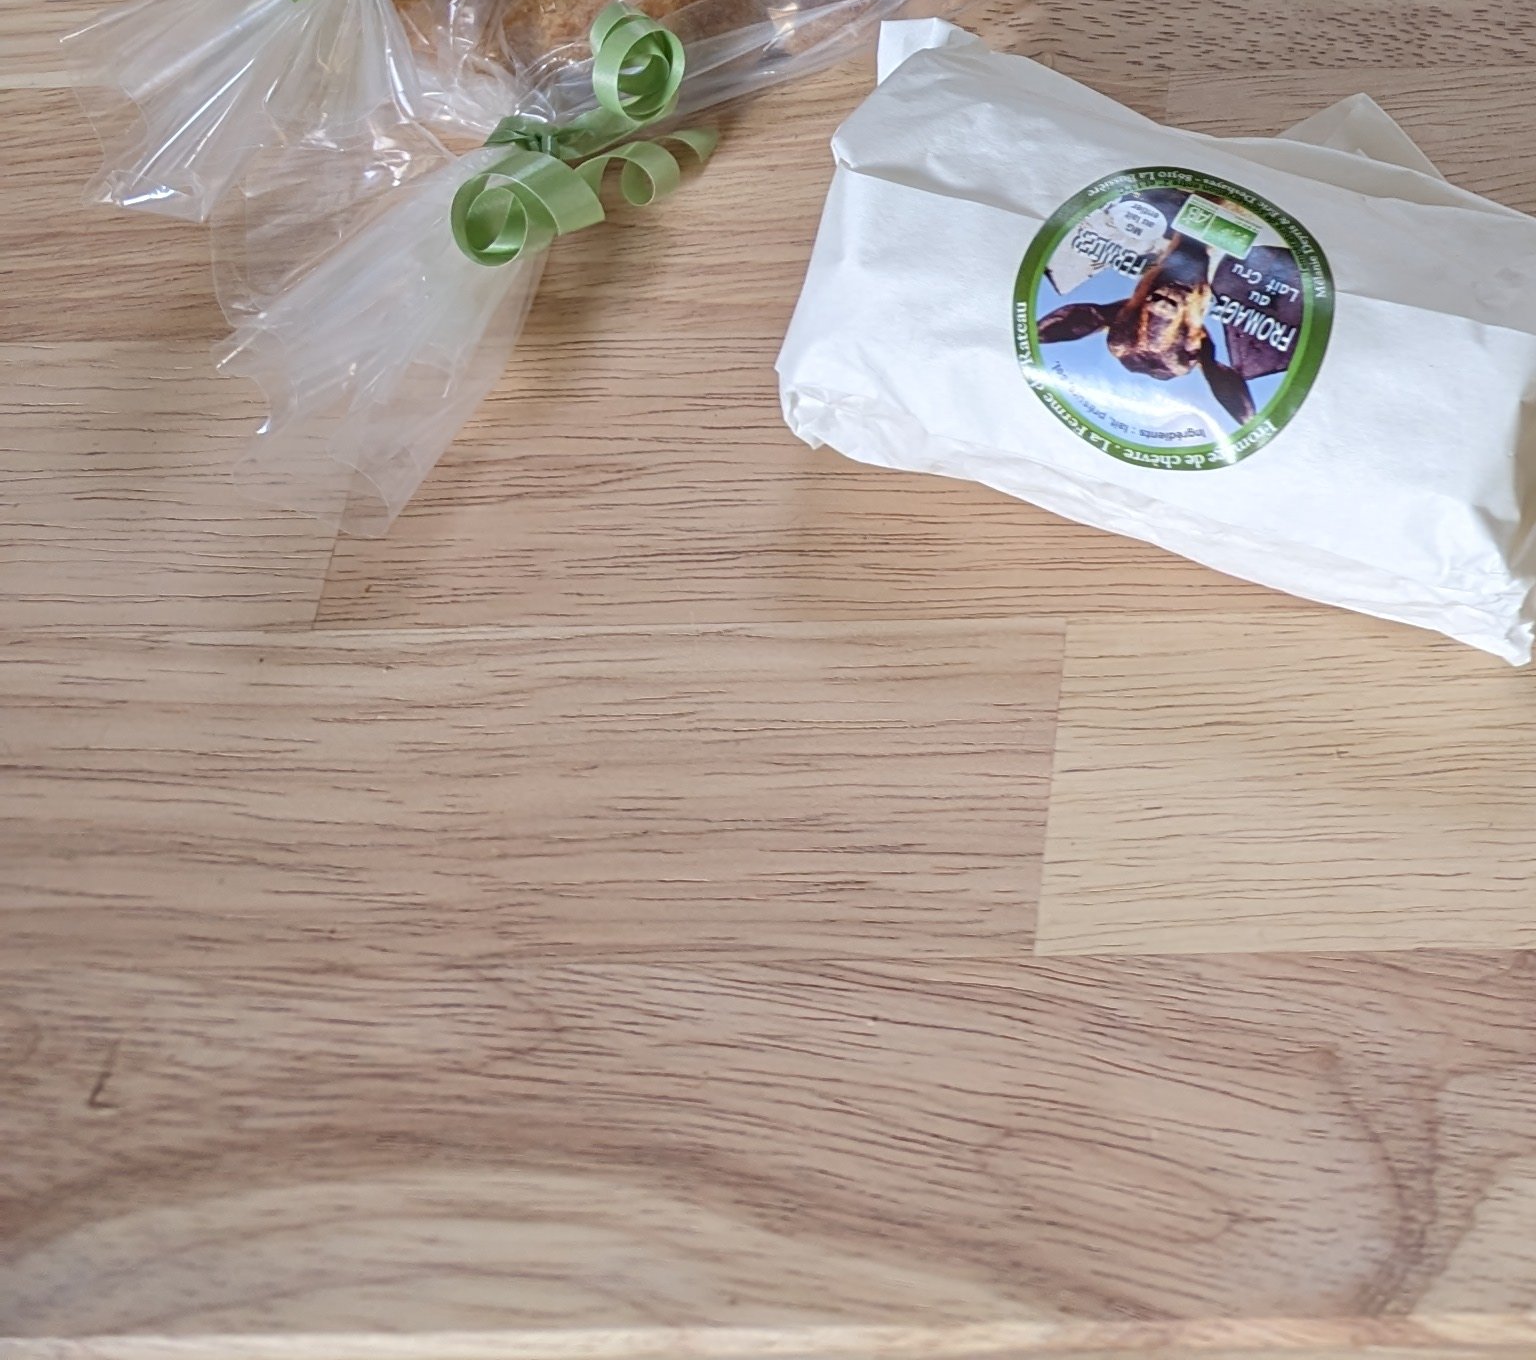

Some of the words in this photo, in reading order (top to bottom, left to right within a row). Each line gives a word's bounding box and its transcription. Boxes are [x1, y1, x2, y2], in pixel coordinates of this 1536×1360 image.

[1072, 230, 1148, 280] FERMIER
[1231, 263, 1262, 284] Cru
[1308, 255, 1327, 298] Mélanie
[1248, 291, 1270, 306] au
[1265, 279, 1300, 303] Lait
[1208, 295, 1297, 352] FROMAGE
[1043, 392, 1089, 436] Ferme
[1089, 430, 1112, 452] La
[1123, 448, 1182, 469] chèvre
[1184, 453, 1205, 469] de
